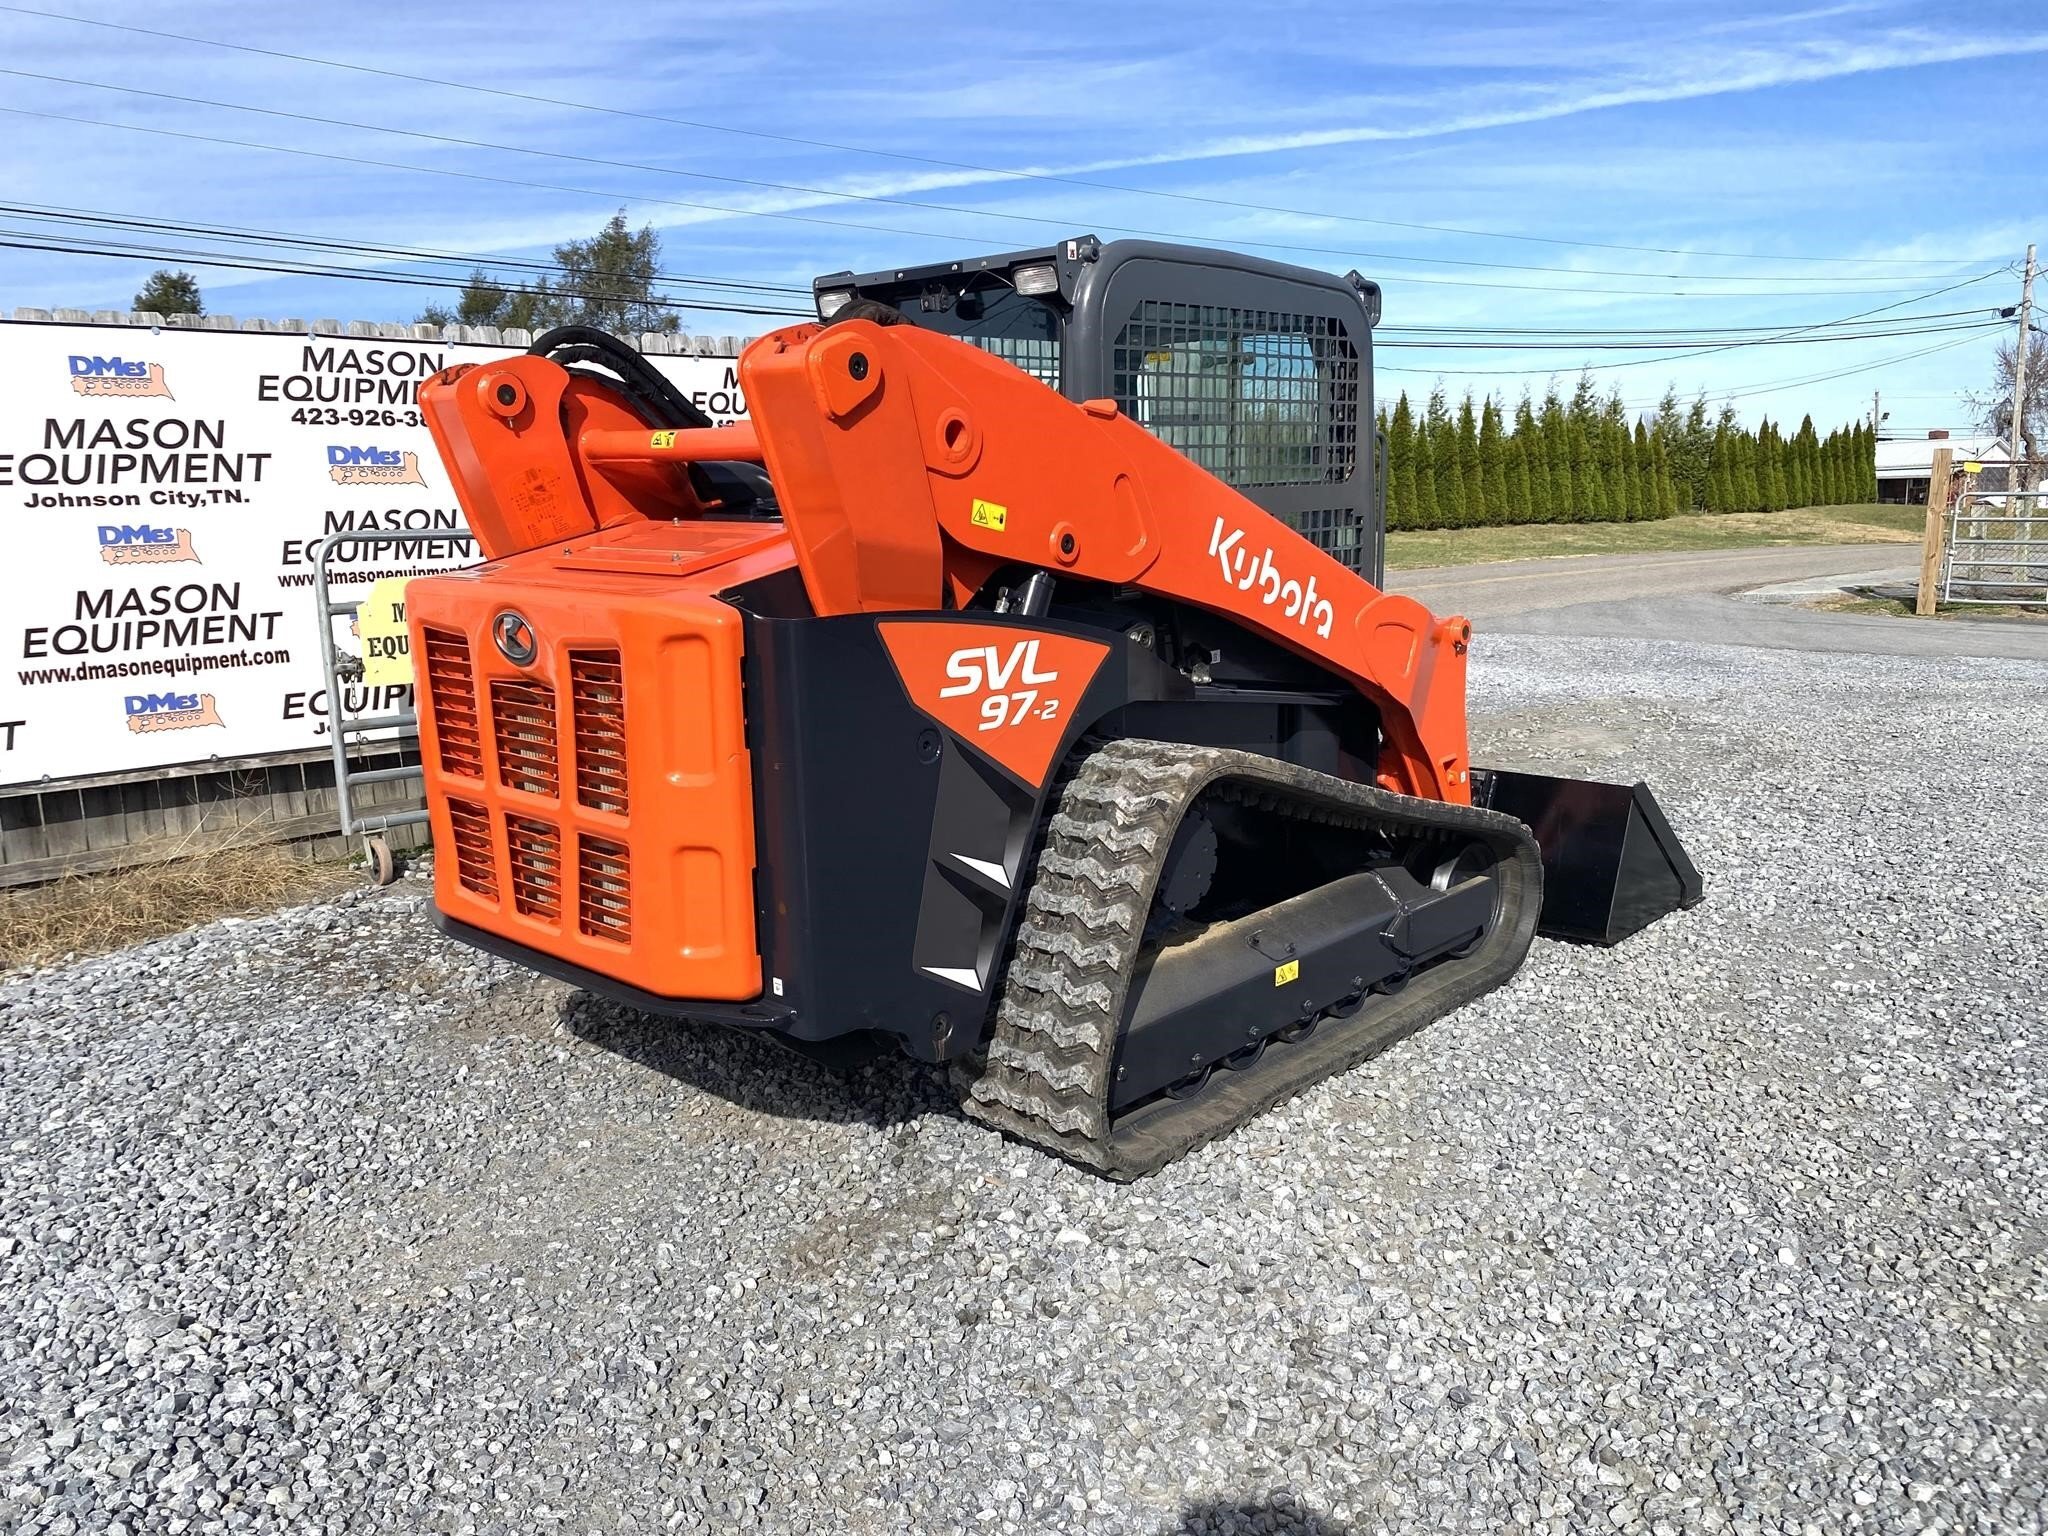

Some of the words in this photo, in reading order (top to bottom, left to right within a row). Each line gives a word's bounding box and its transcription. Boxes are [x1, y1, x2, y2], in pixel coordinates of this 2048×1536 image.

[302, 345, 444, 378] MASON
[258, 375, 423, 405] EQUIPM
[44, 418, 224, 450] MASON
[0, 453, 272, 486] EQUIPMENT
[24, 493, 141, 508] Johnson
[1208, 515, 1334, 640] Kubota
[75, 582, 240, 620] MASON
[23, 611, 283, 658] EQUIPMENT
[18, 649, 290, 686] www.dmasonequipment.com
[939, 639, 1059, 699] SVL
[978, 690, 1060, 731] 97-2
